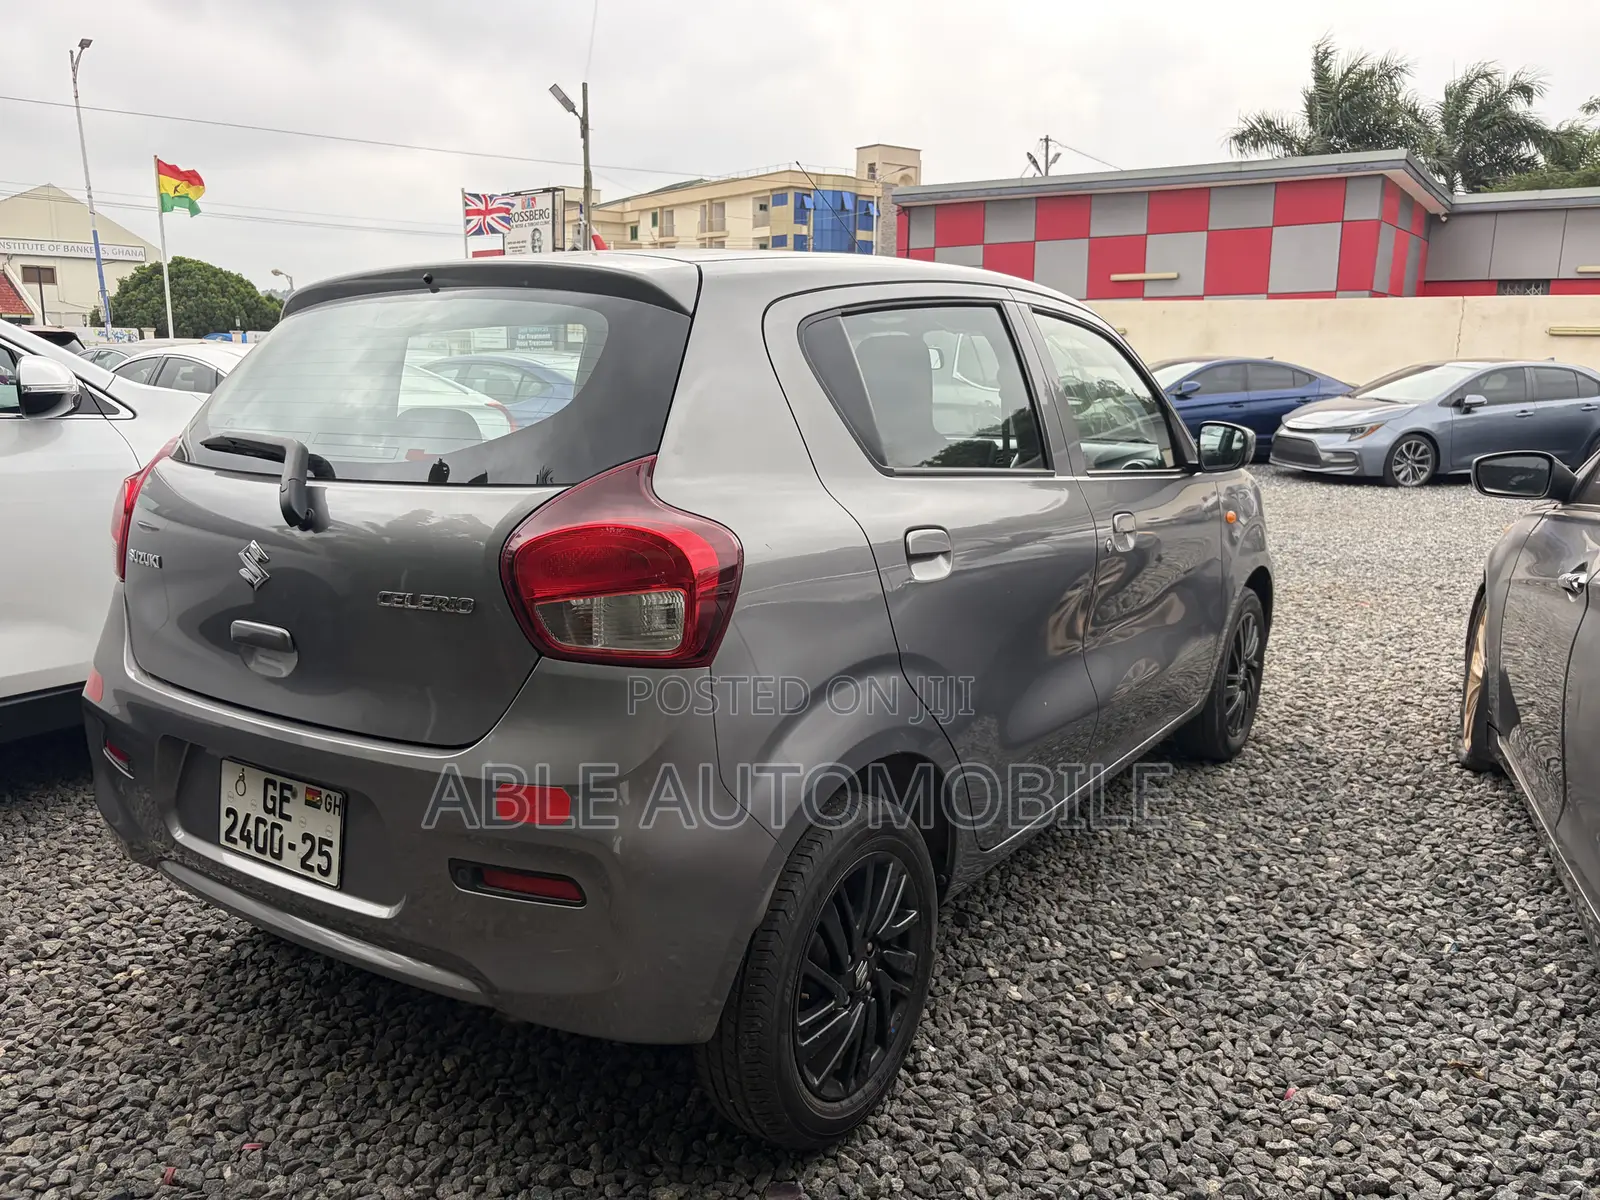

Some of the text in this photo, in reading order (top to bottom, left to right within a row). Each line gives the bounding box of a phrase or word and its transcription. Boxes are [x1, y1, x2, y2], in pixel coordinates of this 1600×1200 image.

[48, 244, 61, 252] OF
[111, 248, 144, 257] GHANA
[129, 548, 162, 569] SUZUKI
[377, 590, 475, 614] CELERIO
[263, 777, 294, 823] GE
[324, 793, 342, 817] GH
[224, 806, 334, 878] 2400-25
